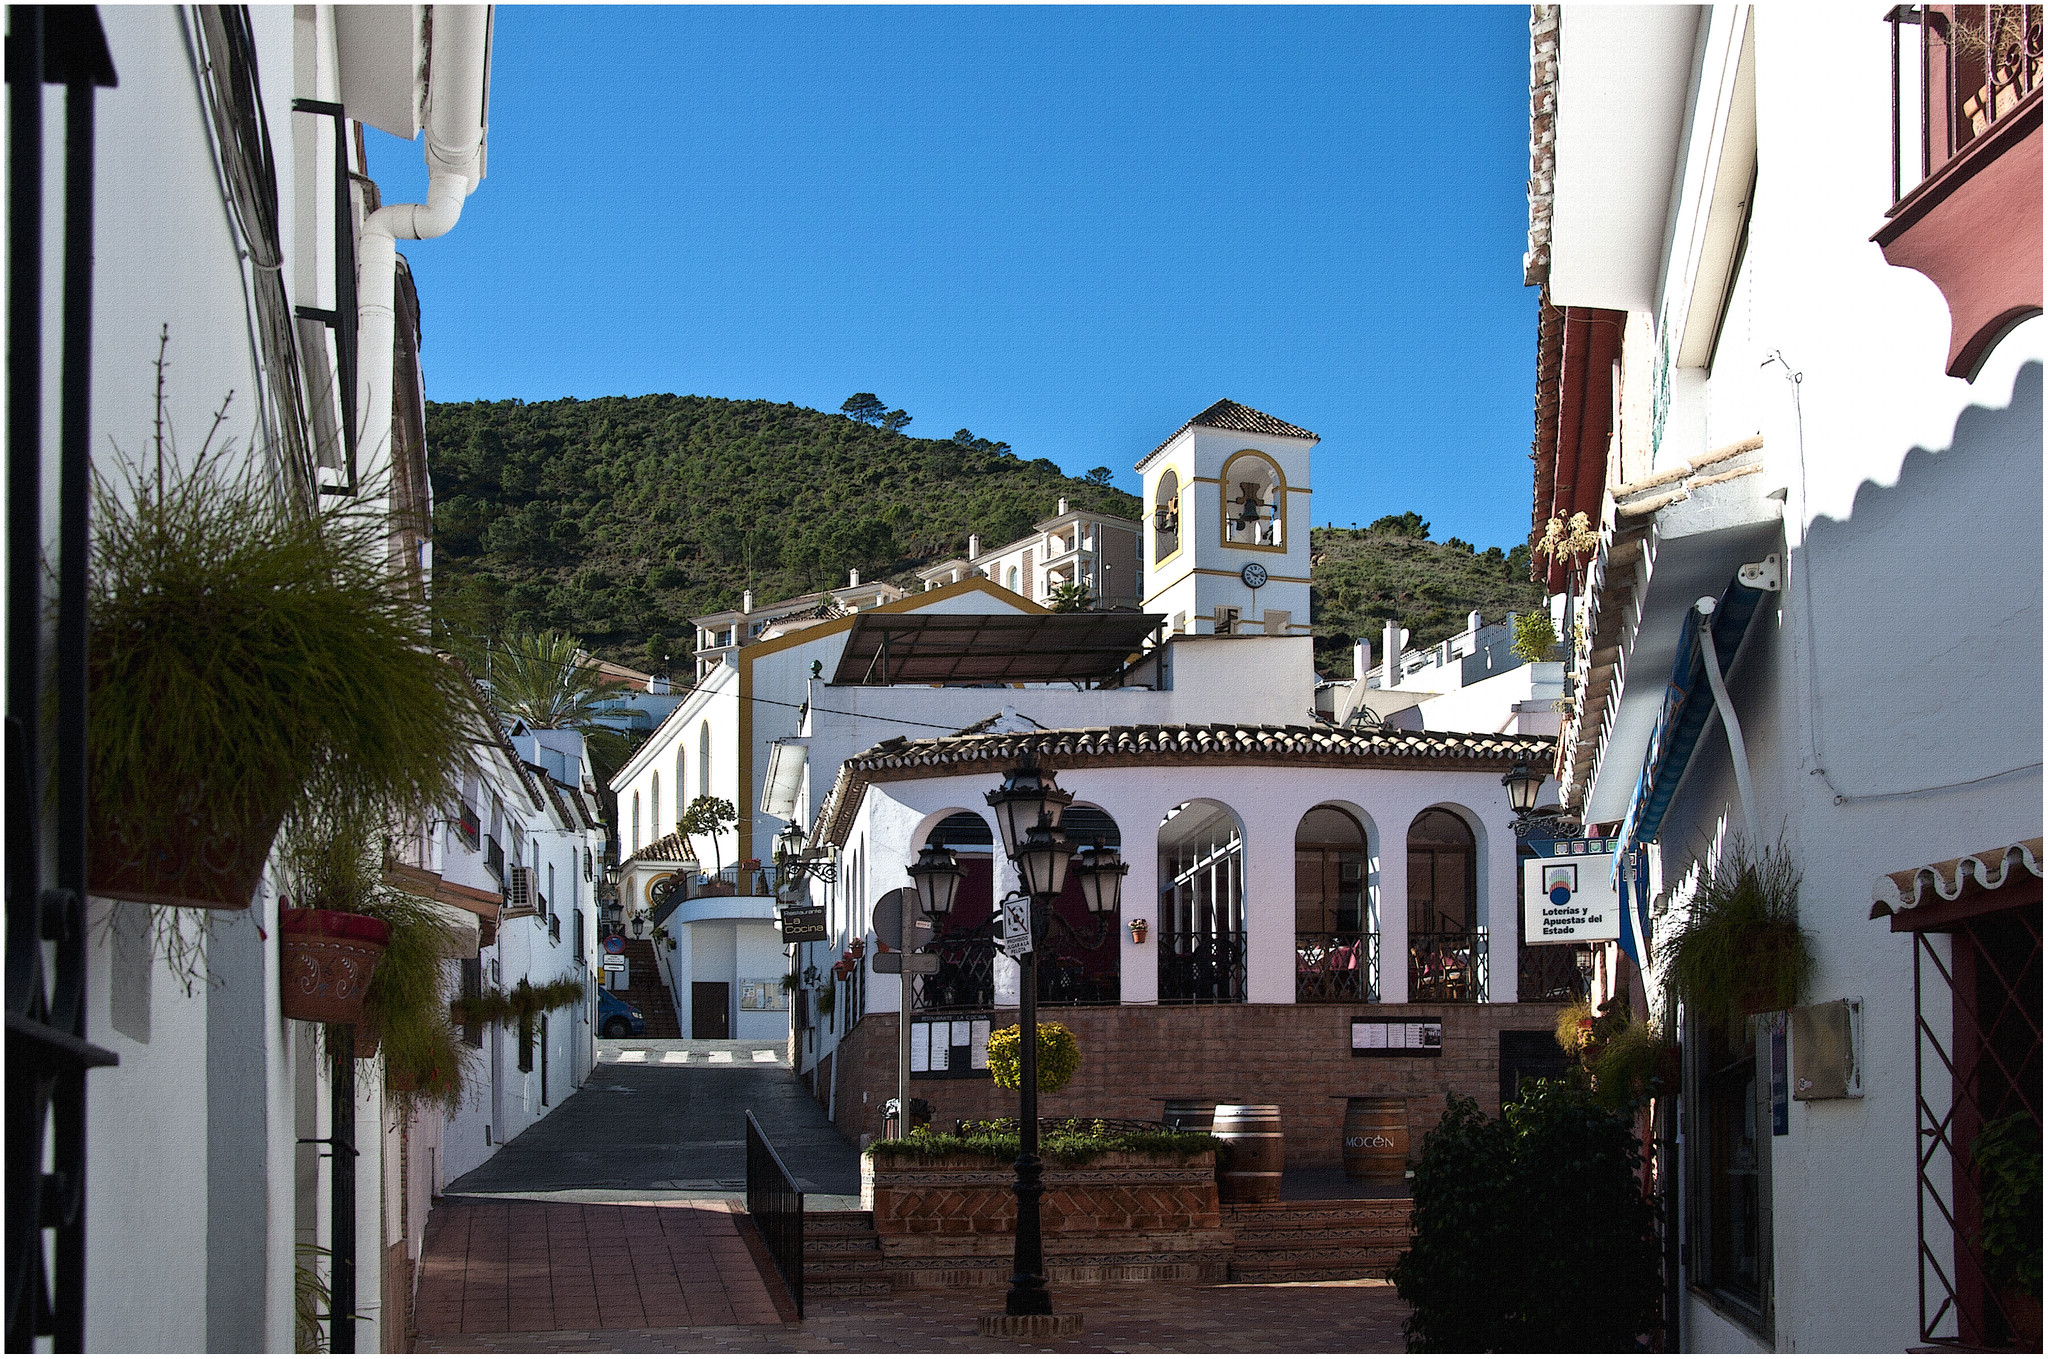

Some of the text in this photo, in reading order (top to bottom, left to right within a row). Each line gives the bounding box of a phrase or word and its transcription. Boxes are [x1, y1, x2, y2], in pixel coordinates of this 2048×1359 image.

[1542, 907, 1580, 916] Loterías
[783, 917, 801, 925] La
[1543, 915, 1602, 927] Apuestas del
[784, 925, 824, 934] Cocina
[1542, 926, 1575, 935] Estado
